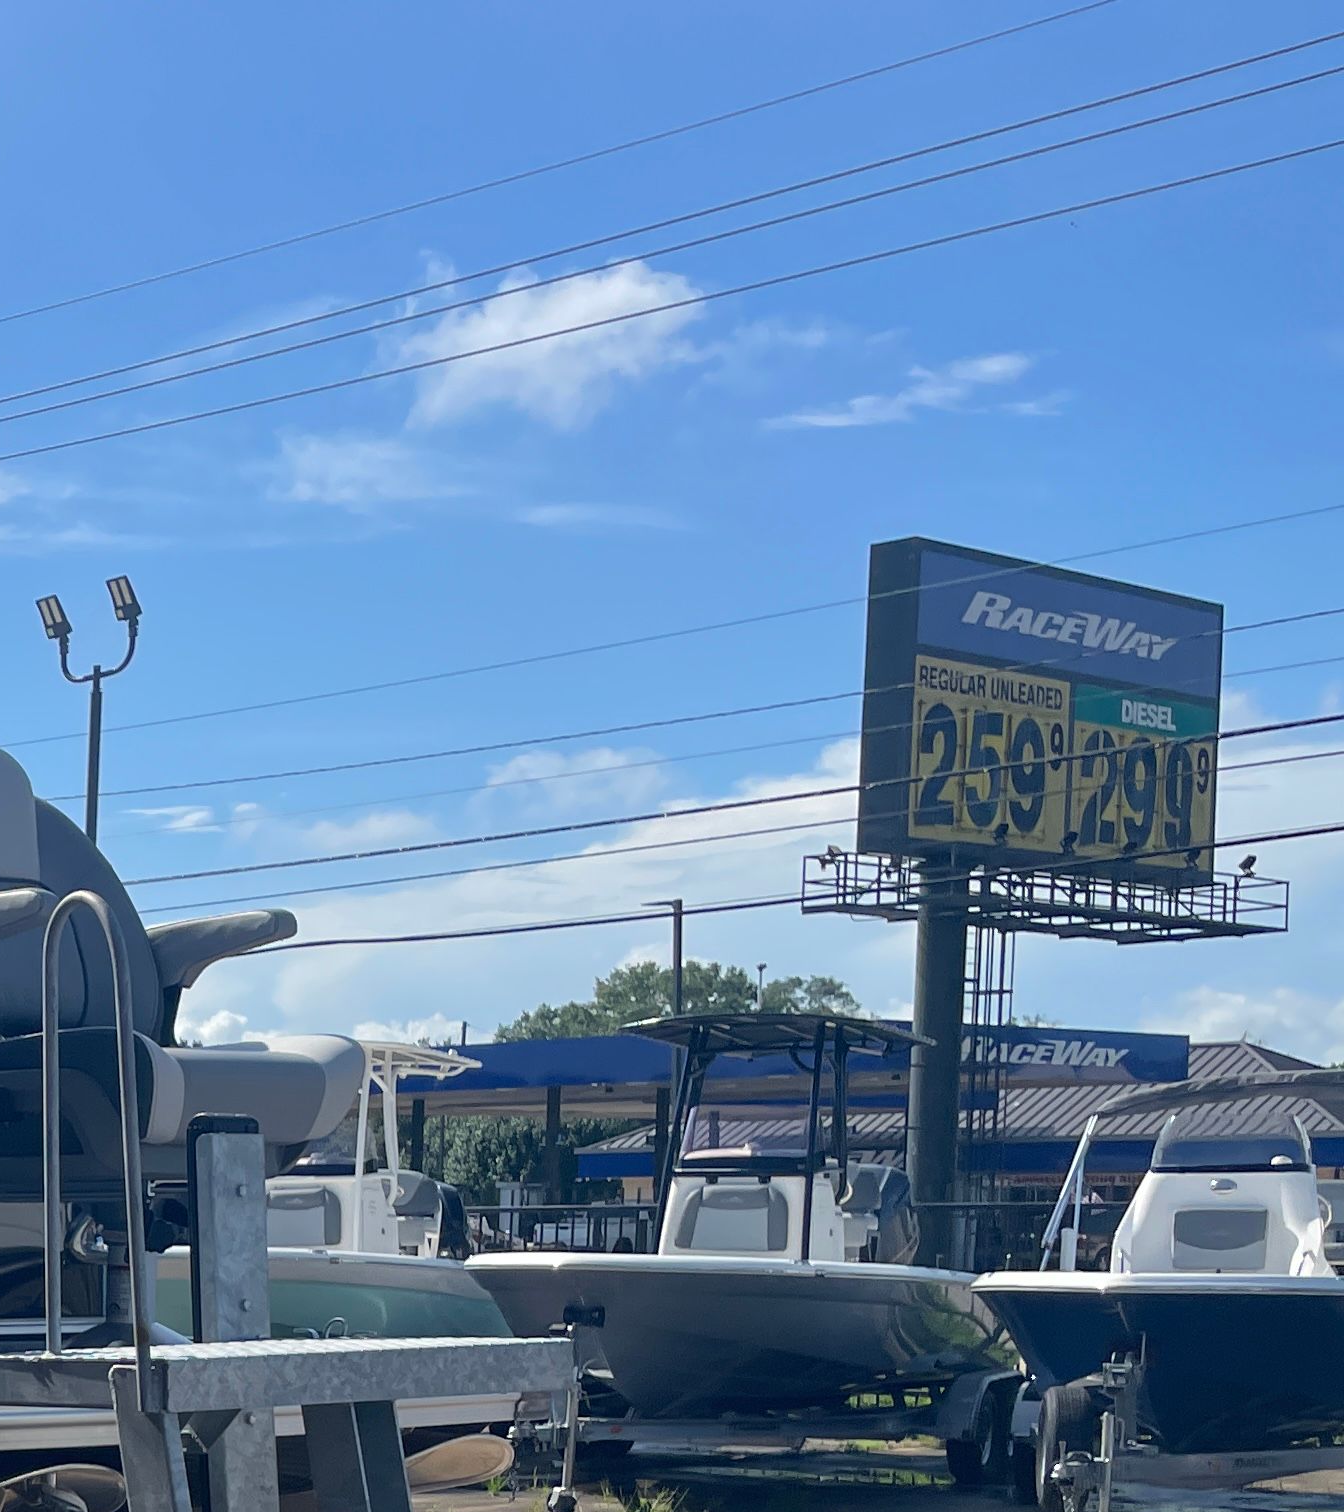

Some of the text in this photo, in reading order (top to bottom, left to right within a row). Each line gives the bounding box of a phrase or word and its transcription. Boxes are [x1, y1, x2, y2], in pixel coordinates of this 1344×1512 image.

[919, 664, 1063, 711] REGULAR UNLEADED
[1121, 698, 1177, 732] DIESEL
